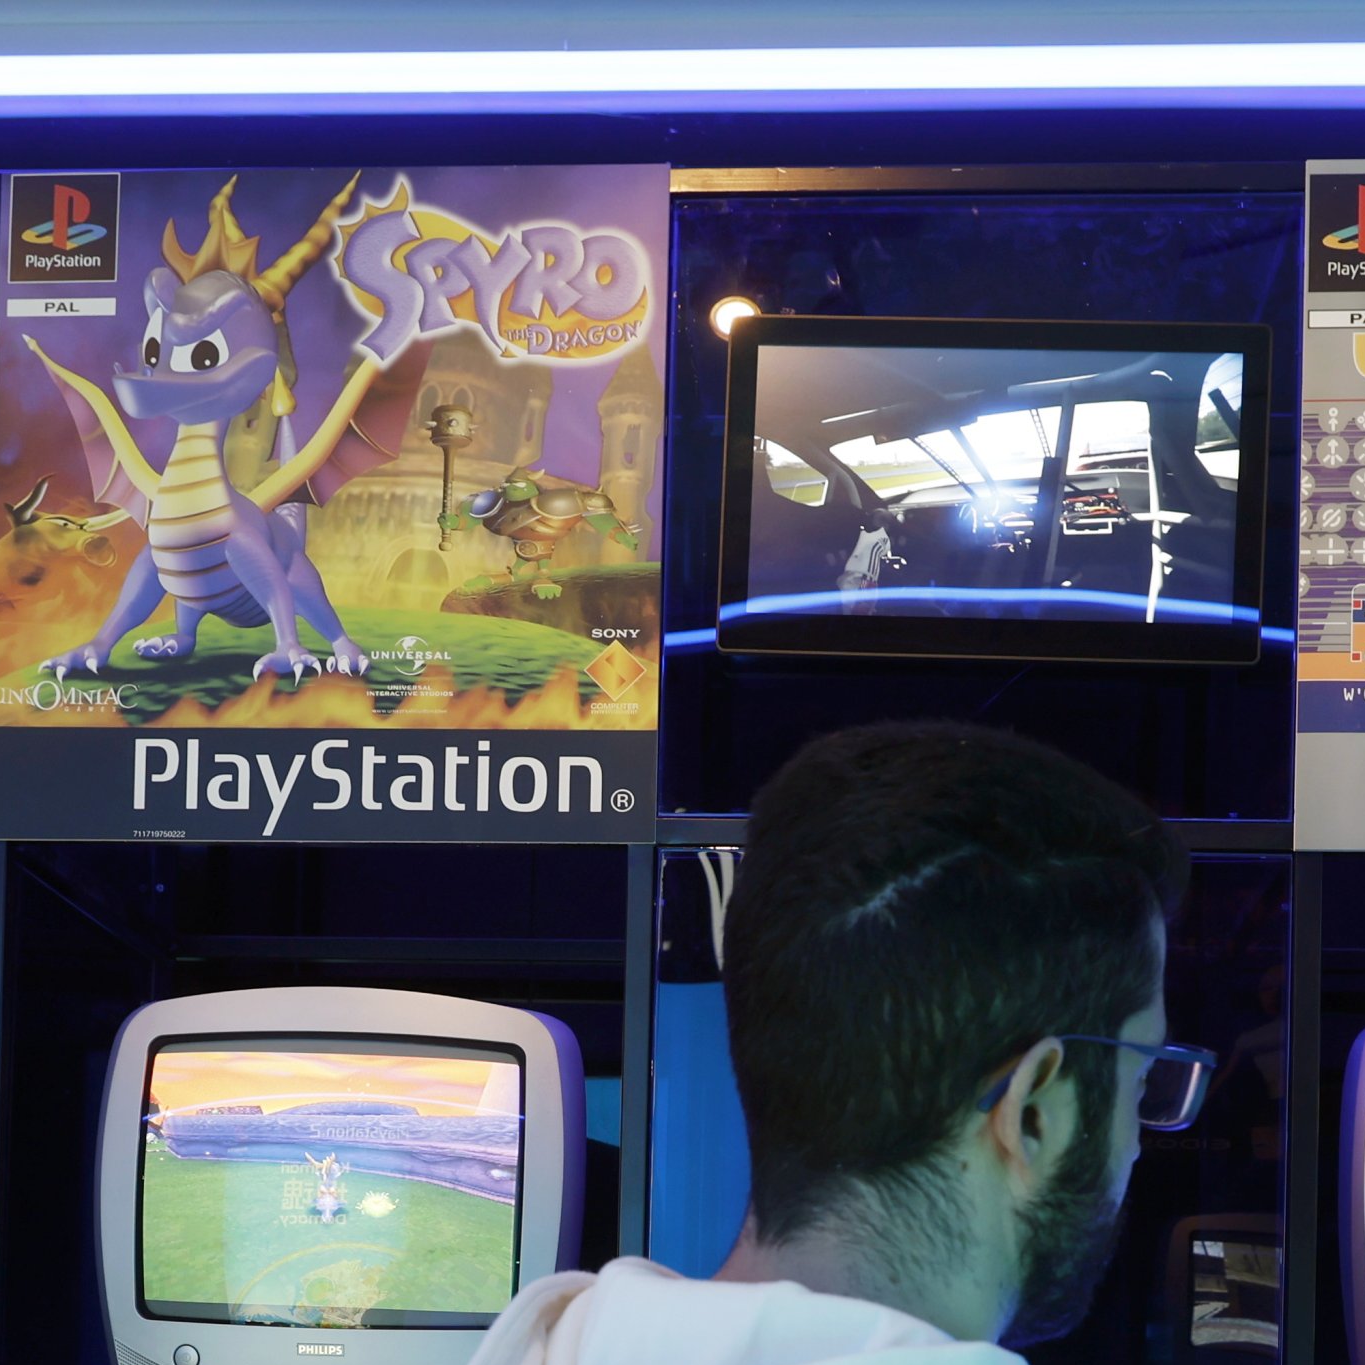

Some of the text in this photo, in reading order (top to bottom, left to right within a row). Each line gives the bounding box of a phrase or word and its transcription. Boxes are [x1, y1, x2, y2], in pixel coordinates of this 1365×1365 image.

[25, 253, 102, 272] PlayStation
[342, 208, 647, 362] SPYRO
[44, 302, 80, 313] PAL
[506, 322, 638, 356] THE DRAGON
[591, 628, 641, 639] SONY
[370, 650, 452, 660] UNIVERSAL
[298, 1344, 343, 1355] PHILIPS
